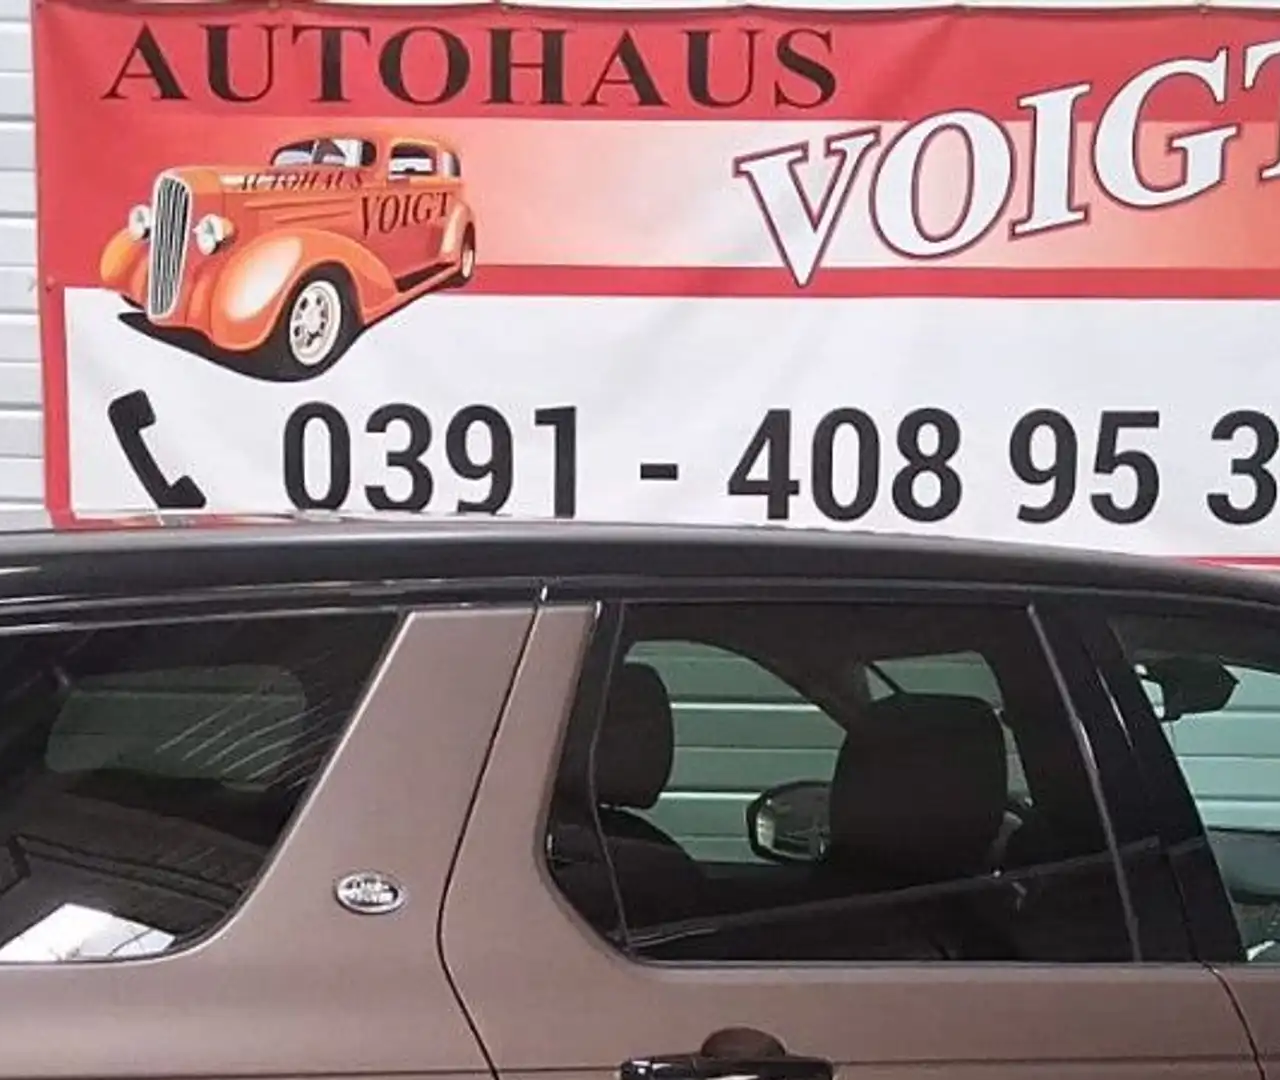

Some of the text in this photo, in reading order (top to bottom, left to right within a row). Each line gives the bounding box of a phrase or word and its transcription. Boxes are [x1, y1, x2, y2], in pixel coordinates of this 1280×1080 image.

[100, 21, 837, 110] AUTOHAUS
[360, 190, 455, 239] VOIGT
[282, 400, 578, 520] 0391
[640, 462, 680, 481] -
[726, 407, 964, 524] 408
[1008, 408, 1161, 526] 95
